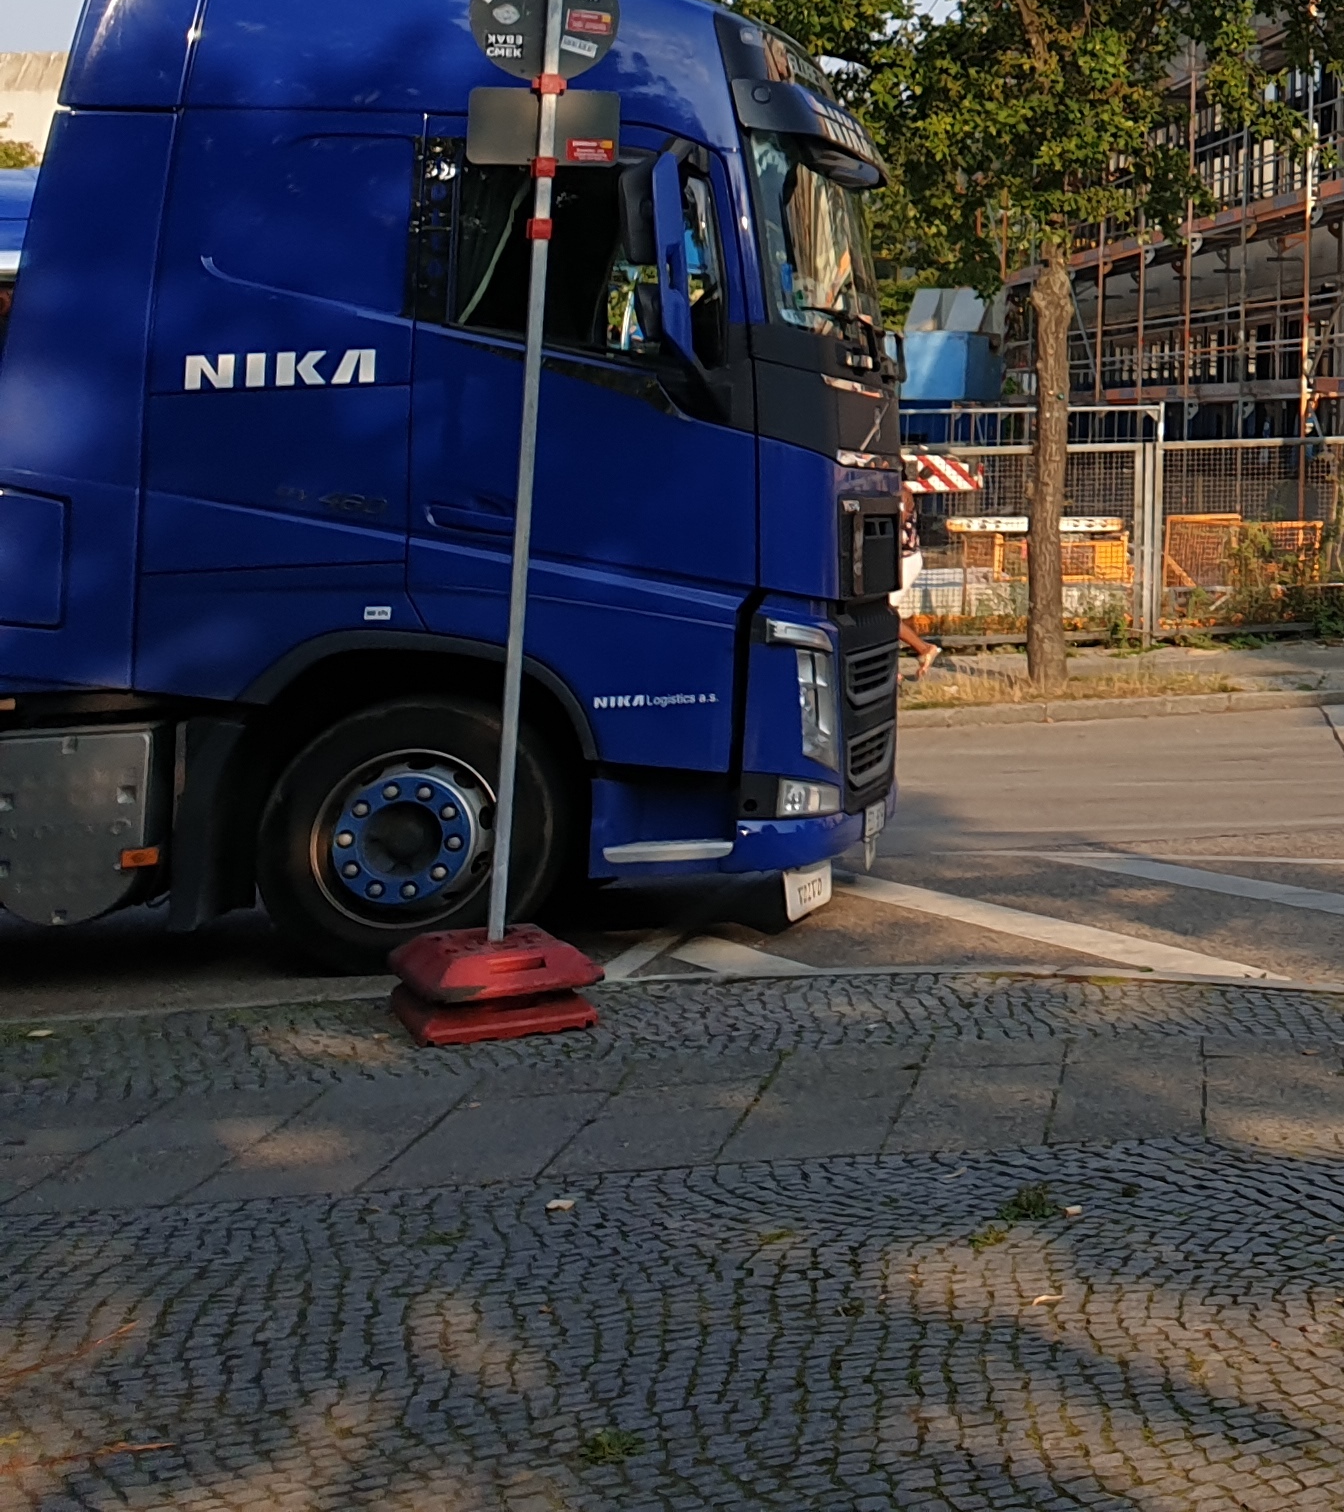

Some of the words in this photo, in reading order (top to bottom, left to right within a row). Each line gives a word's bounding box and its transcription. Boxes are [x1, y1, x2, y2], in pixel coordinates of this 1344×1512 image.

[184, 348, 376, 390] NIKA
[593, 694, 645, 709] NIKA
[646, 692, 696, 708] Logistics
